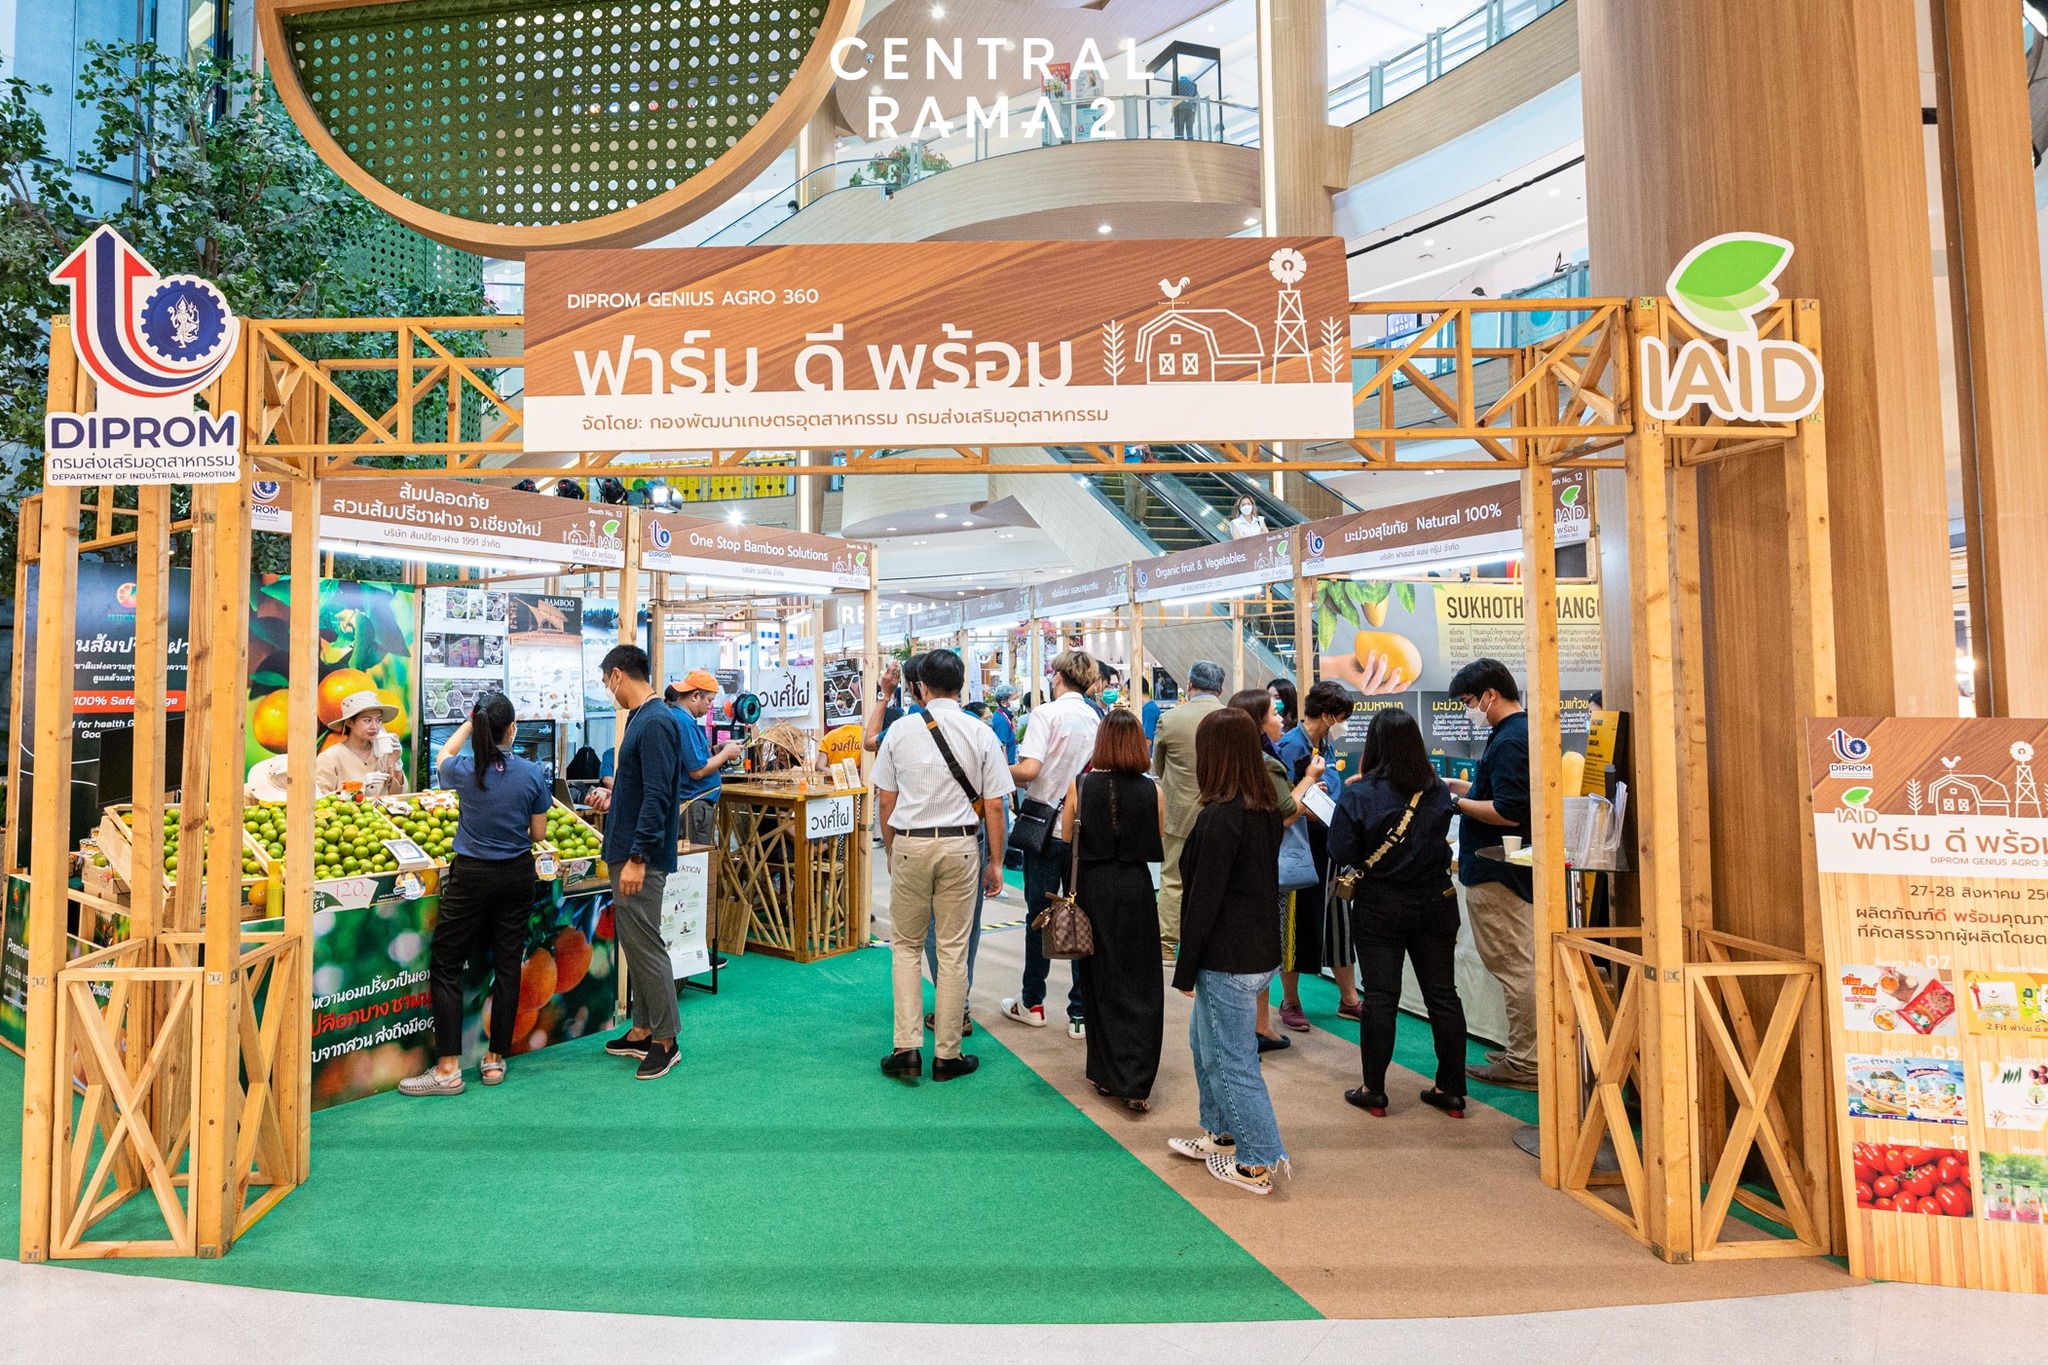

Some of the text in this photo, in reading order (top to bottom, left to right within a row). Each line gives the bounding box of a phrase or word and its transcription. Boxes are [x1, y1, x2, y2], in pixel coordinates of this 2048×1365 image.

[567, 288, 819, 309] DIPROM GENIUS AGRO 360
[1395, 316, 1409, 325] ALL
[574, 323, 1072, 396] ฟาร์ม ดี พร้อม
[1647, 343, 1817, 413] IAID
[582, 408, 1109, 431] จัดโดย: กองพัฒนาเกษตรอุตสาหกรรม กรมส่งเสริมอุตสาหกรรม
[51, 416, 235, 449] DIPROM
[52, 452, 235, 471] กรมส่งเสริมอุตสาหกรรม
[130, 472, 180, 480] INDUSTRIAL
[183, 471, 236, 479] PROMOTION
[399, 482, 490, 510] ส้มปลอดภัย
[333, 498, 542, 537] สวนส้มปรีชาฝาง จ.เชียงใหม่
[1344, 503, 1502, 543] มะม่วงสุโขทัย Natural 100%
[384, 529, 407, 538] บริษัท
[462, 537, 479, 546] 1991
[689, 533, 829, 561] One Stop Bamboo Solutions
[1155, 551, 1248, 580] Organic fruit & Vegetables.
[544, 598, 575, 607] BAMBOO
[1447, 596, 1523, 619] SUKHOTH
[73, 696, 135, 705] 100% Safe
[1432, 699, 1466, 711] มะม่วง
[1830, 764, 1872, 772] DIPROM
[1835, 810, 1878, 824] IAID
[1852, 827, 1930, 852] ฟาร์ม
[1945, 827, 1967, 852] ดี
[1930, 856, 1969, 864] DIPROM
[1973, 857, 2007, 866] GENIUS
[1910, 885, 1955, 897] 27-28
[1962, 886, 2021, 899] สิงหาคม
[5, 964, 21, 979] FOLLOW
[1875, 959, 1905, 968] Booth
[1925, 956, 1951, 969] 07
[312, 1001, 390, 1037] ปลือกบาง
[1986, 1023, 1992, 1031] 2
[1995, 1023, 2007, 1031] Fit
[311, 1035, 373, 1063] บจากสวน
[1882, 1048, 1912, 1057] Booth
[1931, 1045, 1959, 1060] 09
[1888, 1136, 1920, 1145] Booth
[1950, 1135, 1967, 1150] 11
